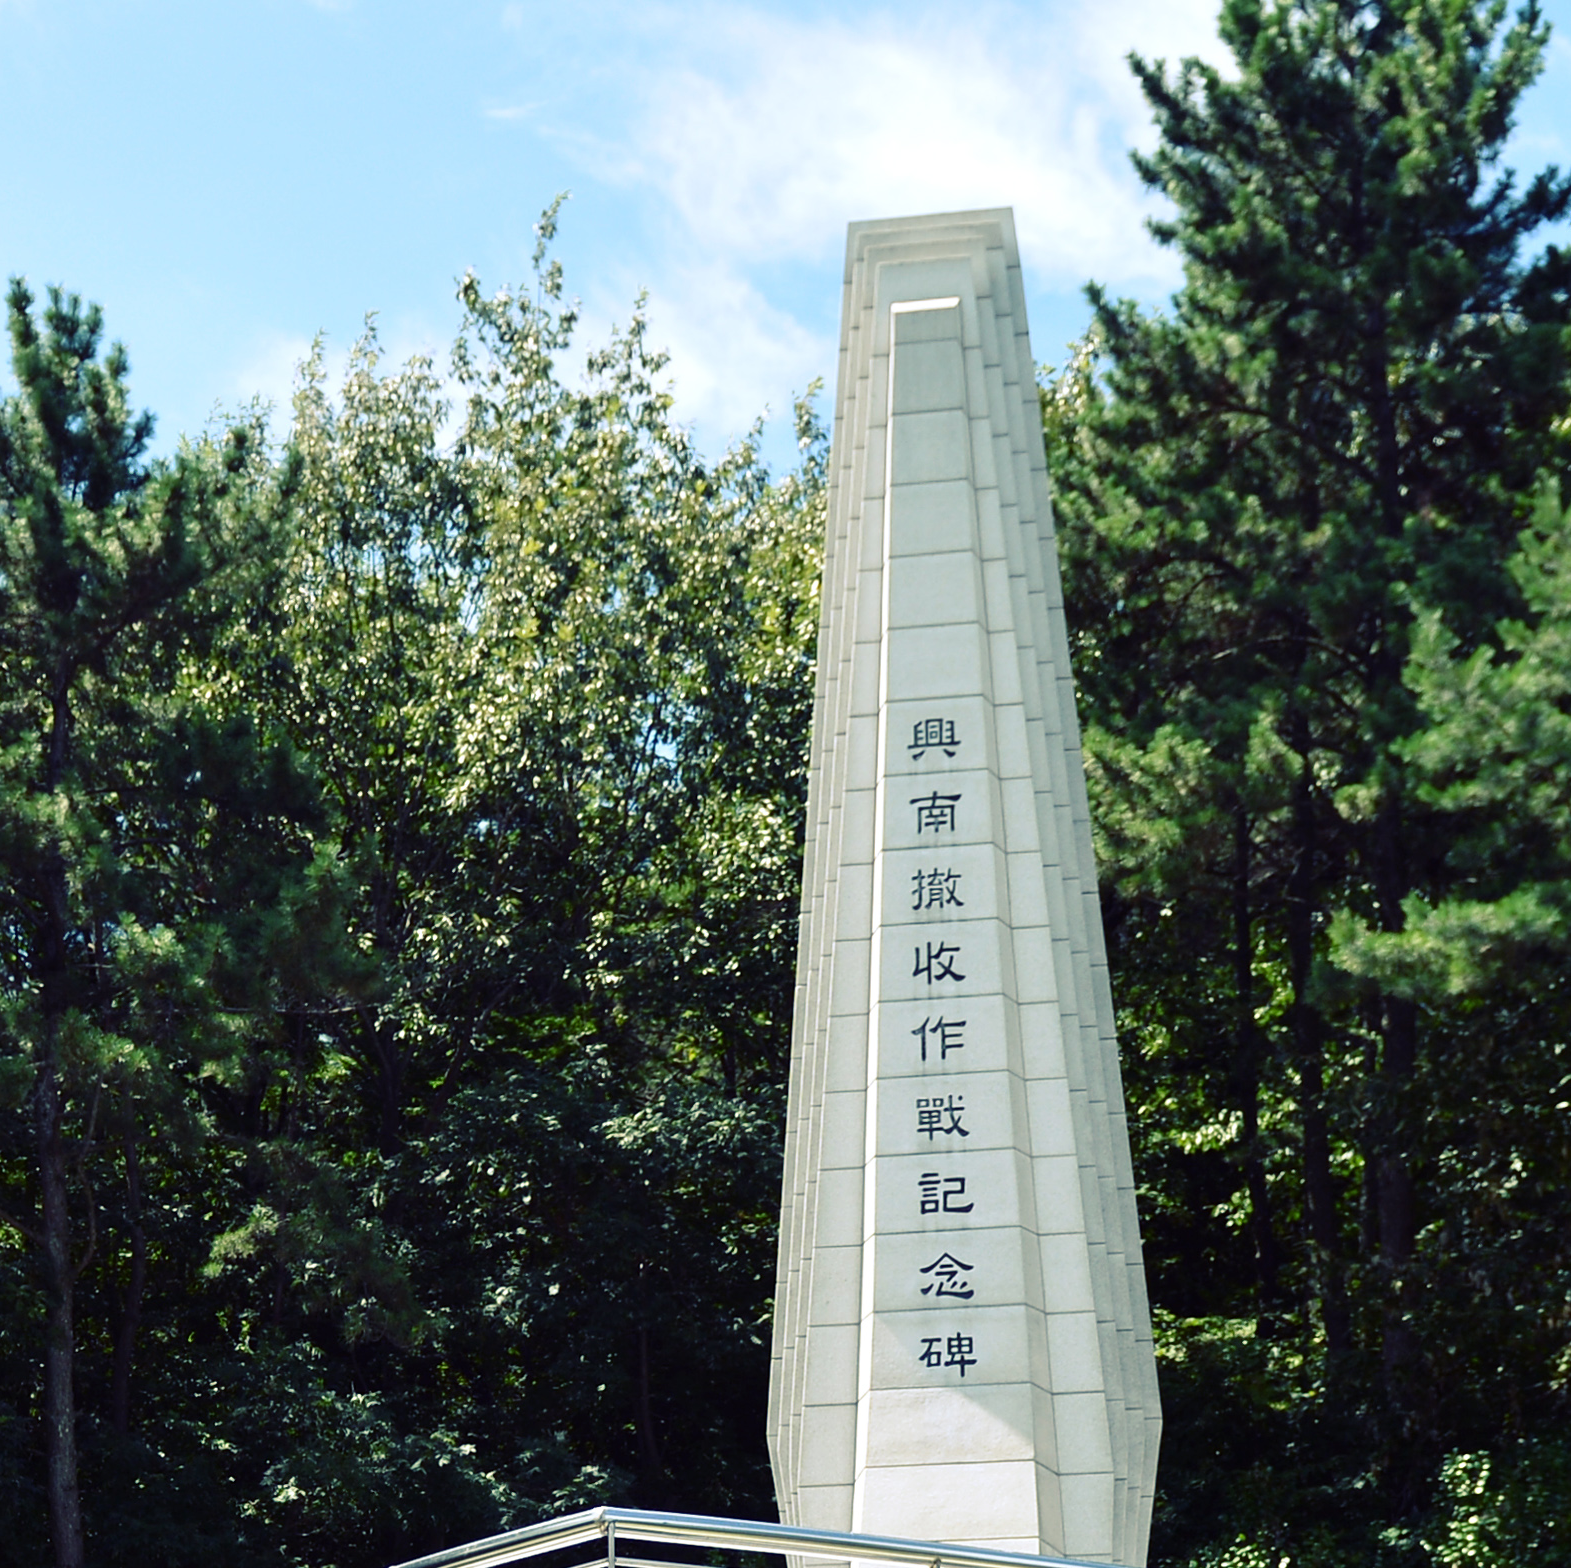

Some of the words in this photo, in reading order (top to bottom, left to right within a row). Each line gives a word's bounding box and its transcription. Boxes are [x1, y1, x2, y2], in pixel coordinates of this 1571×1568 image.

[906, 716, 978, 1379] 興南撤收作戰記念碑
